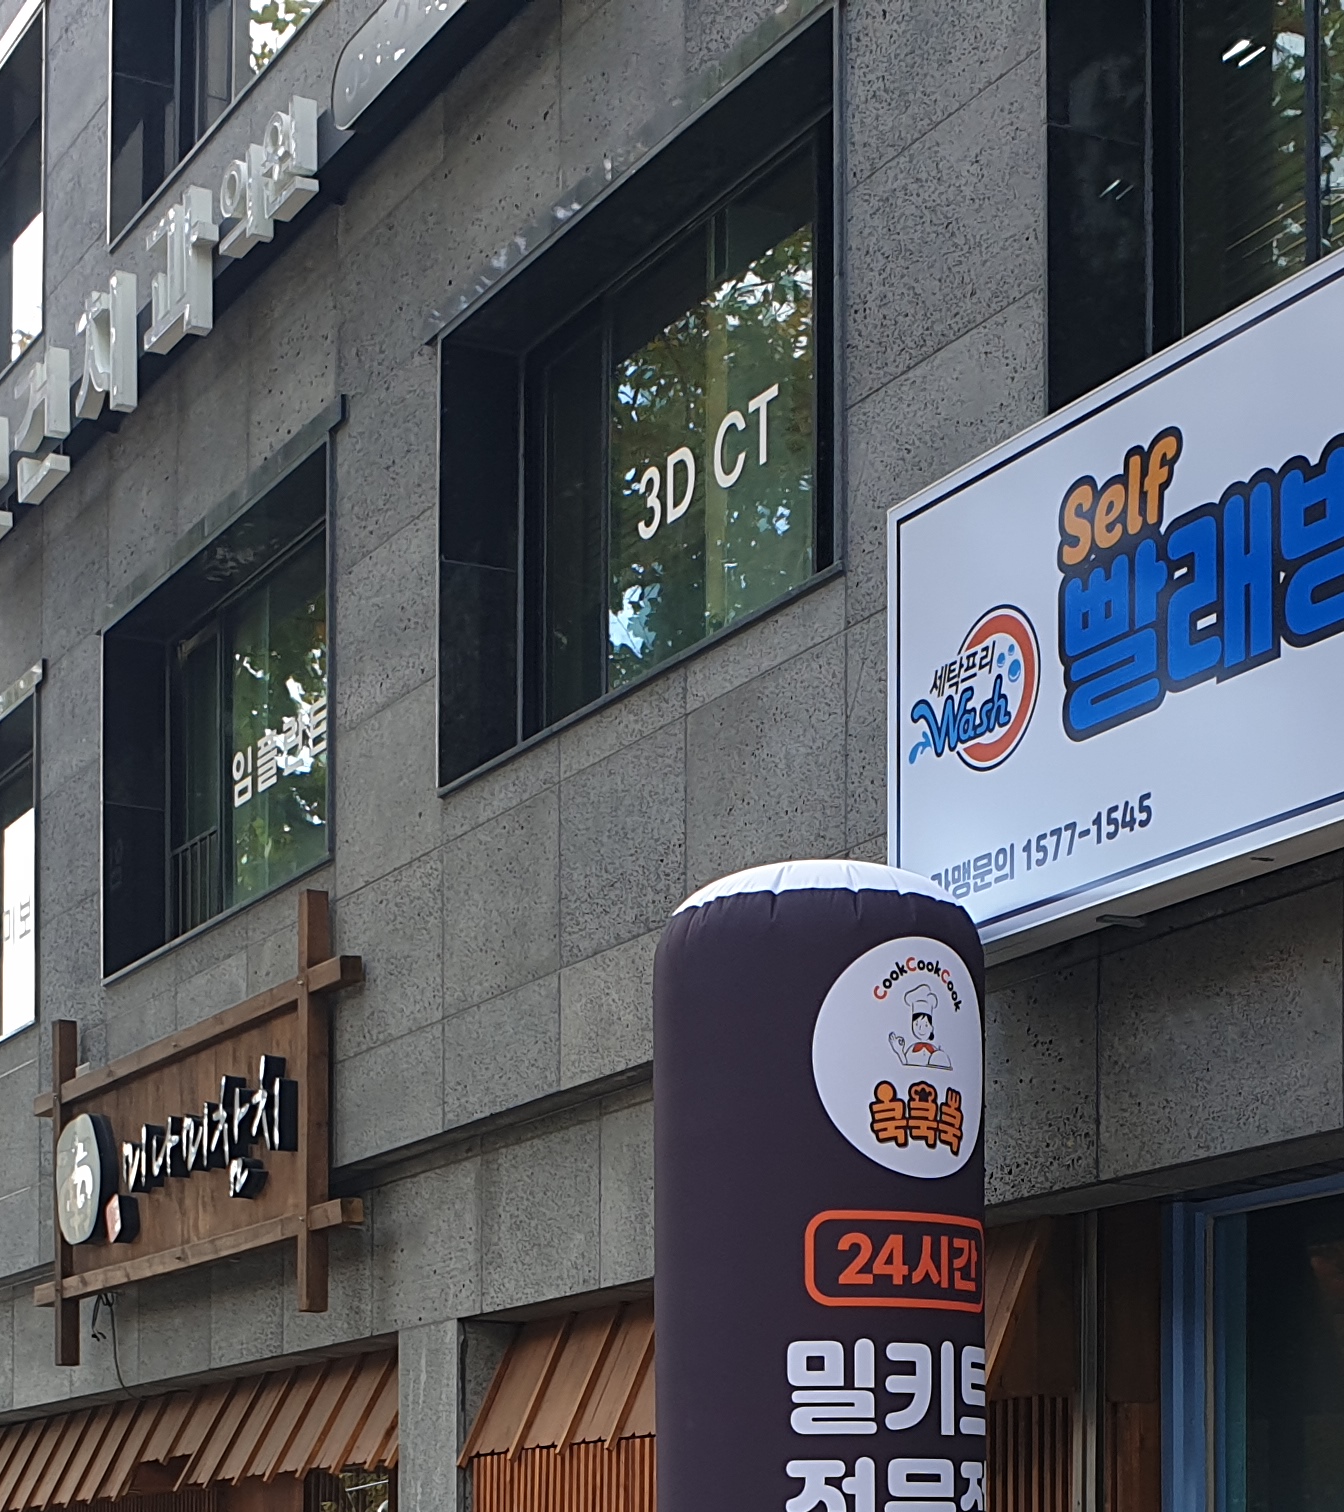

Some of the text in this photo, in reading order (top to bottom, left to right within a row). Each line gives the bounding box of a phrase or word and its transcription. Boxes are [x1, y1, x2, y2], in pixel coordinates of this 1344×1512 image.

[637, 383, 779, 540] 3D CT
[1060, 427, 1182, 571] Self
[911, 674, 1011, 757] Wash
[929, 640, 996, 697] 세탁프리
[930, 791, 1153, 899] 가맹문의 1577-1545
[837, 1231, 978, 1292] 24시간
